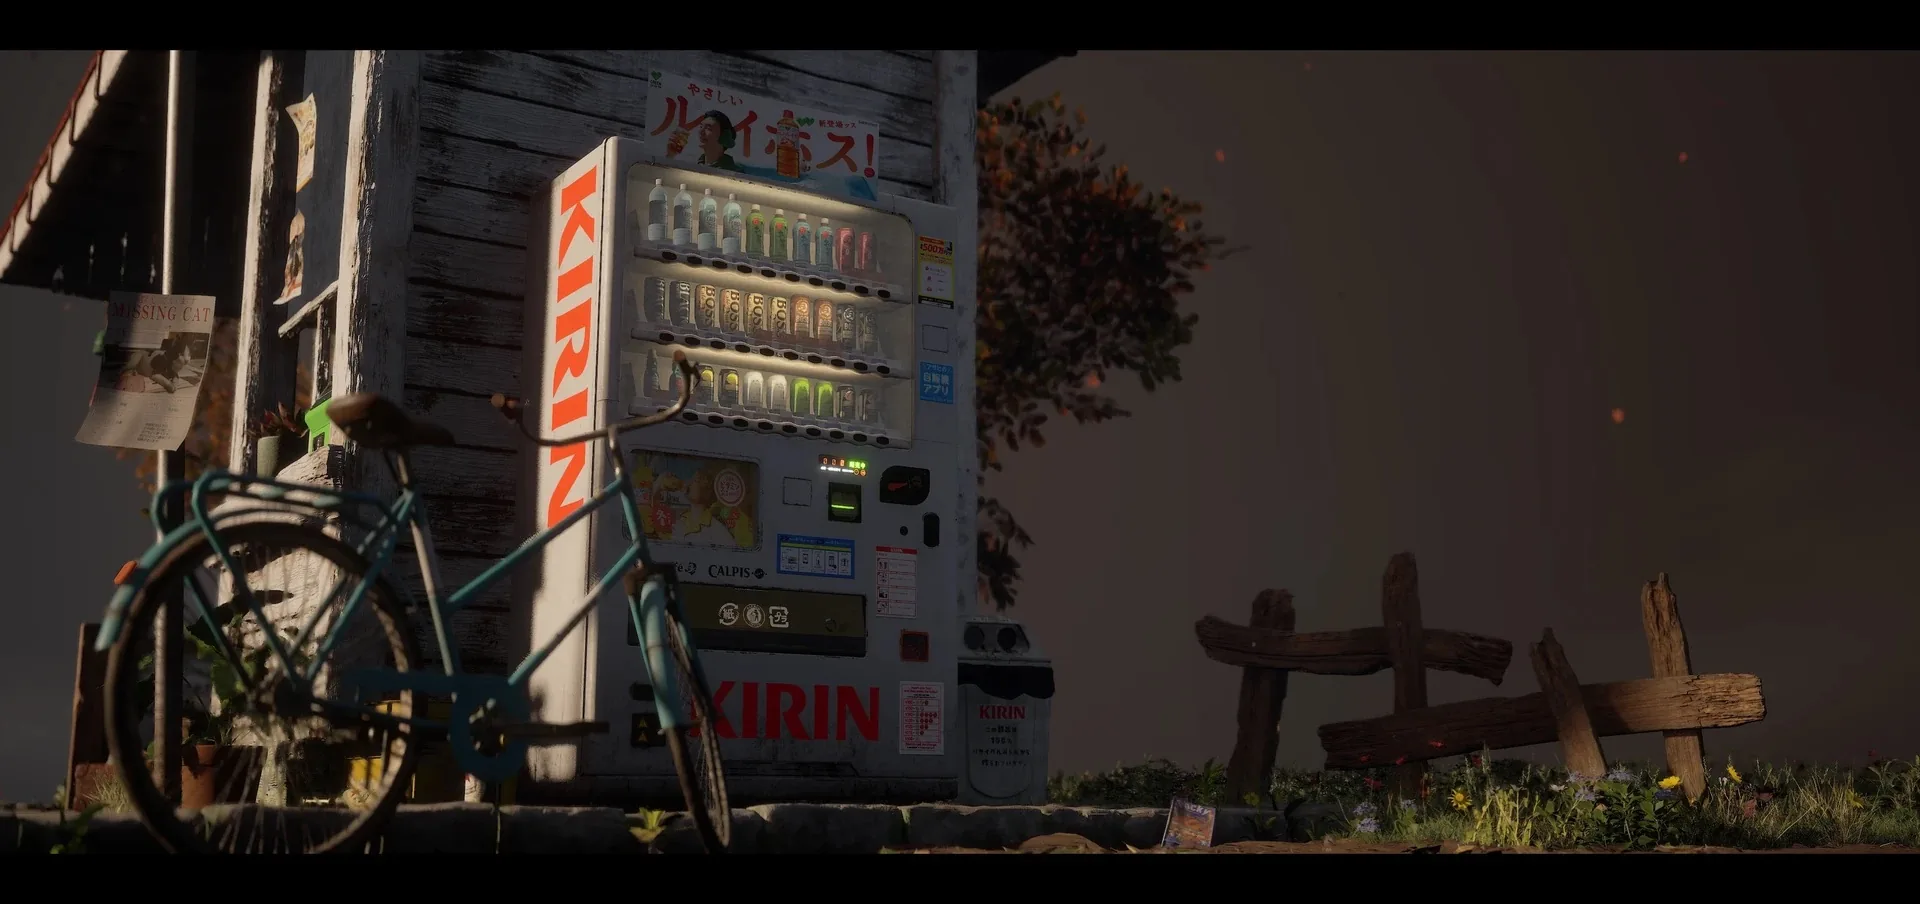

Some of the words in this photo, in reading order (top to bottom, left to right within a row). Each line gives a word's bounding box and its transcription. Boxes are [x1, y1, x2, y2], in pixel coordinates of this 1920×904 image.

[687, 83, 743, 106] やさしい
[111, 303, 177, 322] MISSING
[183, 306, 211, 322] CAT
[547, 164, 598, 530] KIRIN
[708, 564, 750, 578] CALPIS
[690, 681, 880, 742] KIRIN
[979, 706, 1026, 719] KIRIN
